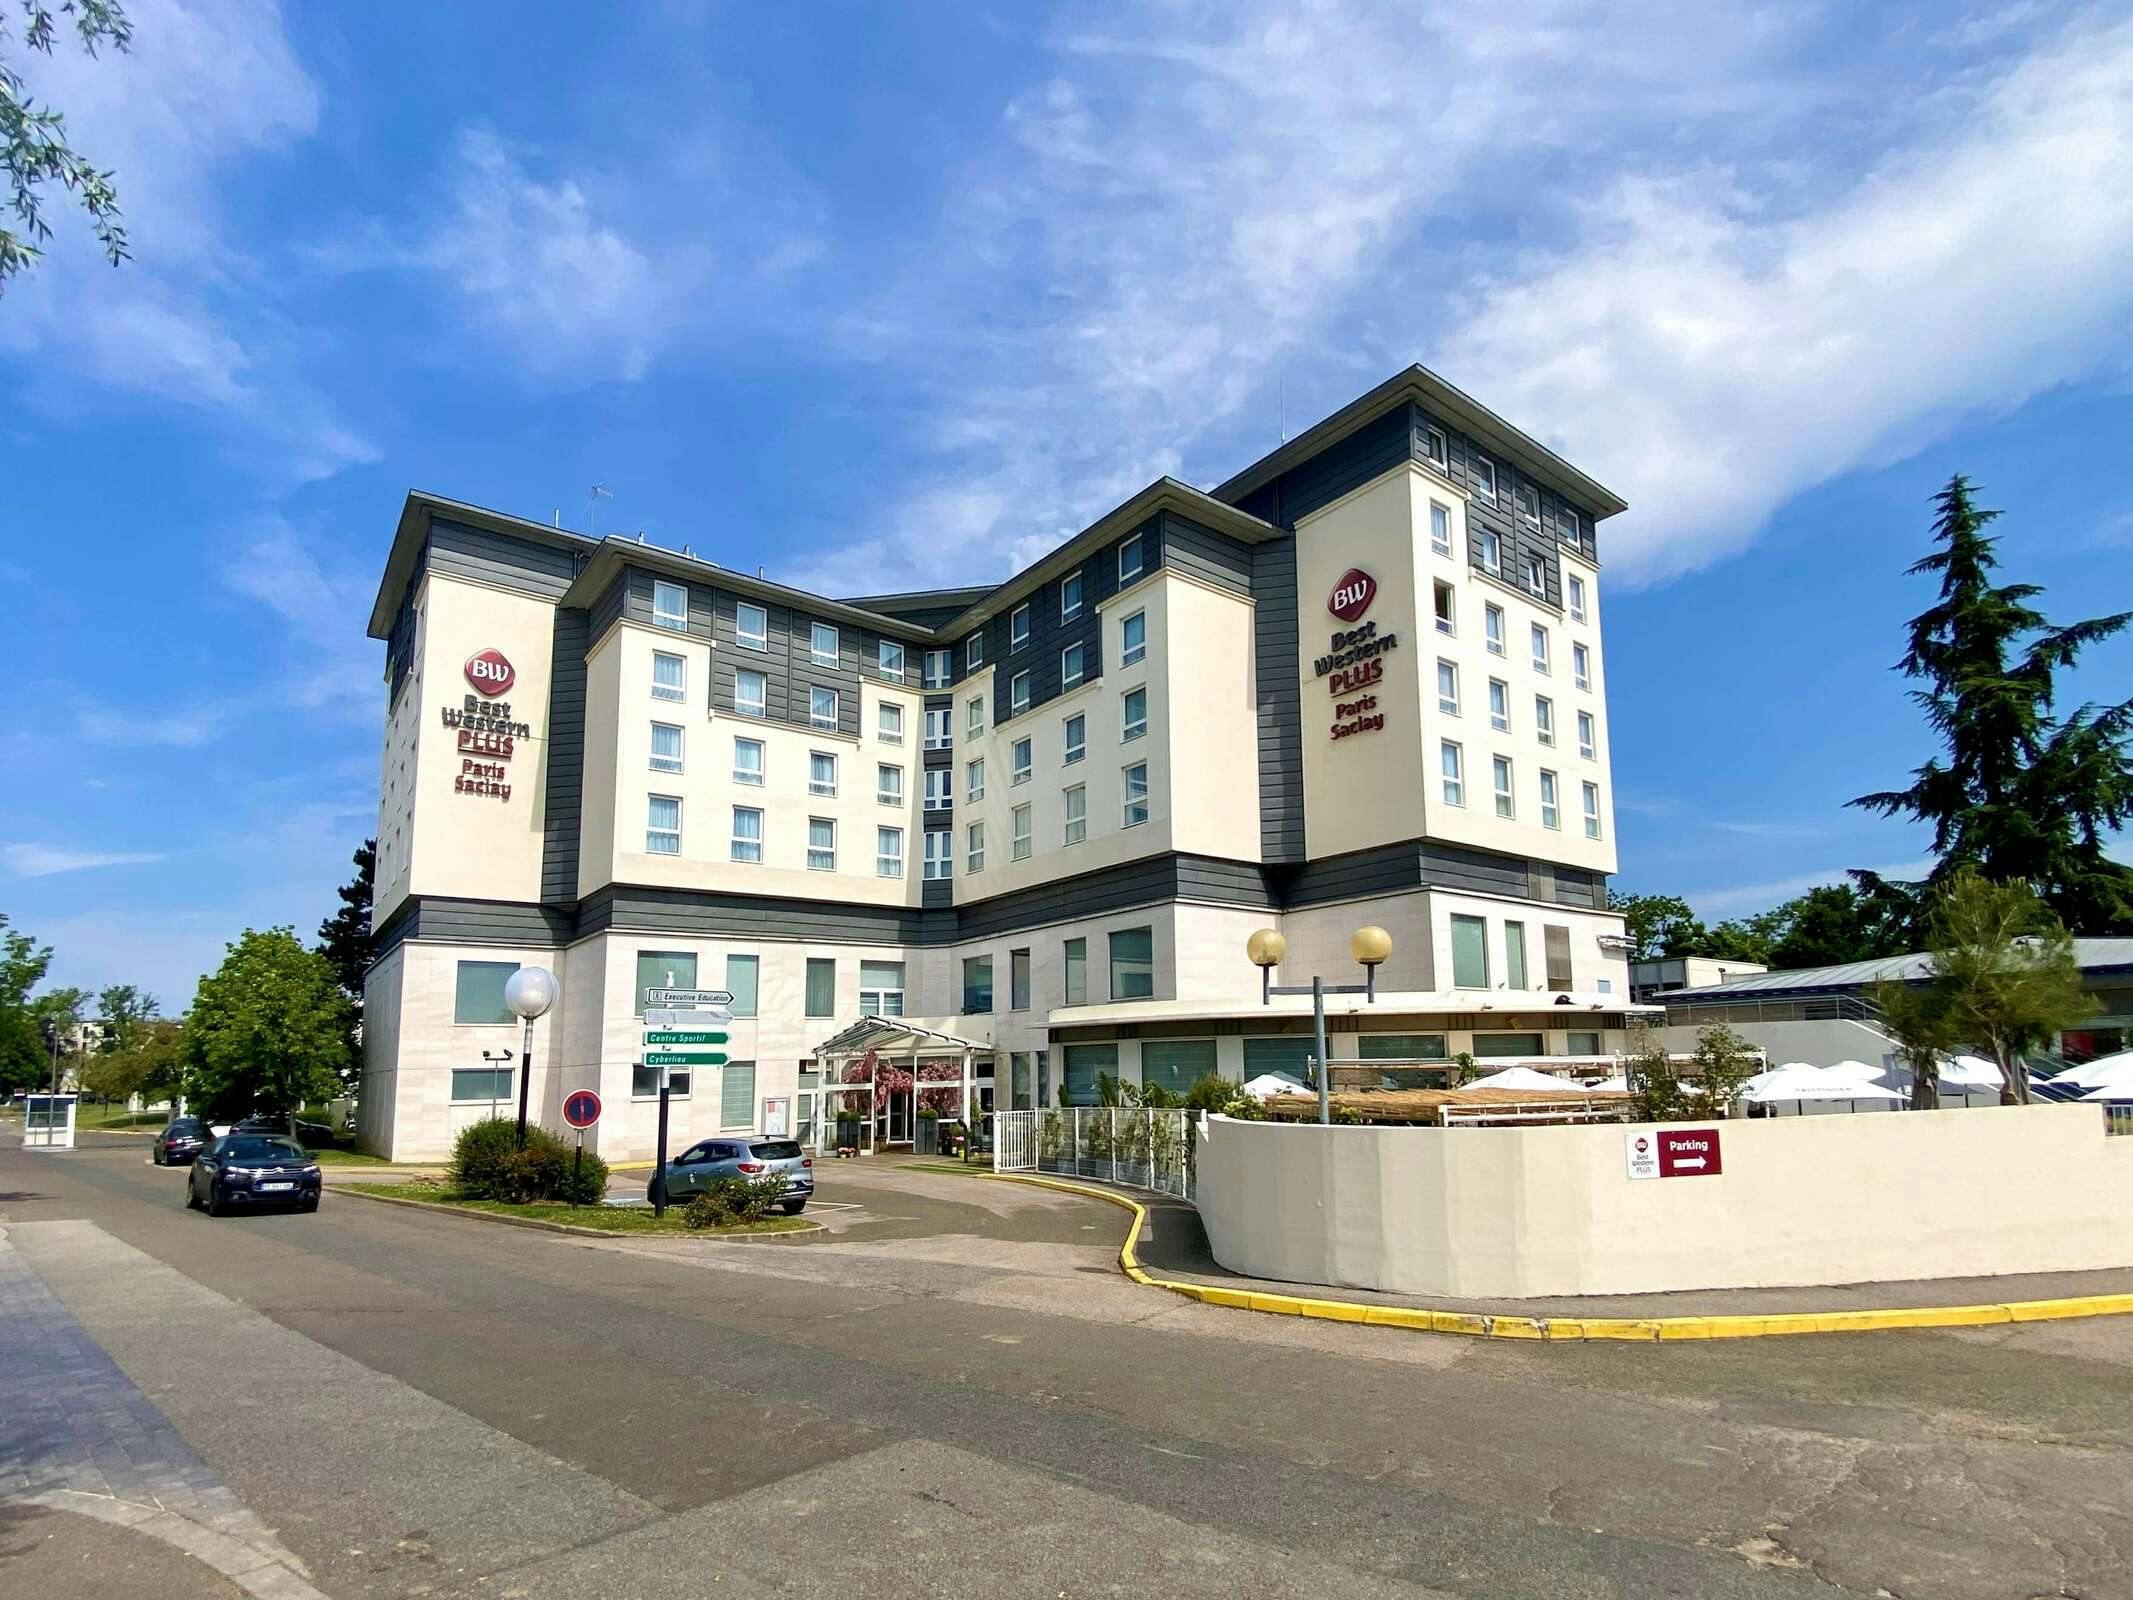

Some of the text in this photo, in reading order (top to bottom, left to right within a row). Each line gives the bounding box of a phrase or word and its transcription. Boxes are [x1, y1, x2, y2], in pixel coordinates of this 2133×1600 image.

[1333, 579, 1368, 611] BW
[1331, 621, 1377, 652] Best
[1314, 633, 1398, 677] Western
[472, 658, 510, 682] BW
[1329, 658, 1383, 694] PLUS
[464, 694, 511, 719] Best
[1335, 694, 1377, 720] Paris
[442, 707, 530, 740] Western
[1330, 713, 1384, 740] Saclay
[458, 729, 514, 756] PLUS
[462, 758, 505, 780] Paris
[455, 775, 511, 802] Saclay
[664, 992, 729, 1002] Executive Education
[650, 1034, 706, 1044] Centre Sportif
[649, 1055, 687, 1064] Cyberlieu
[1669, 1140, 1709, 1152] Parking
